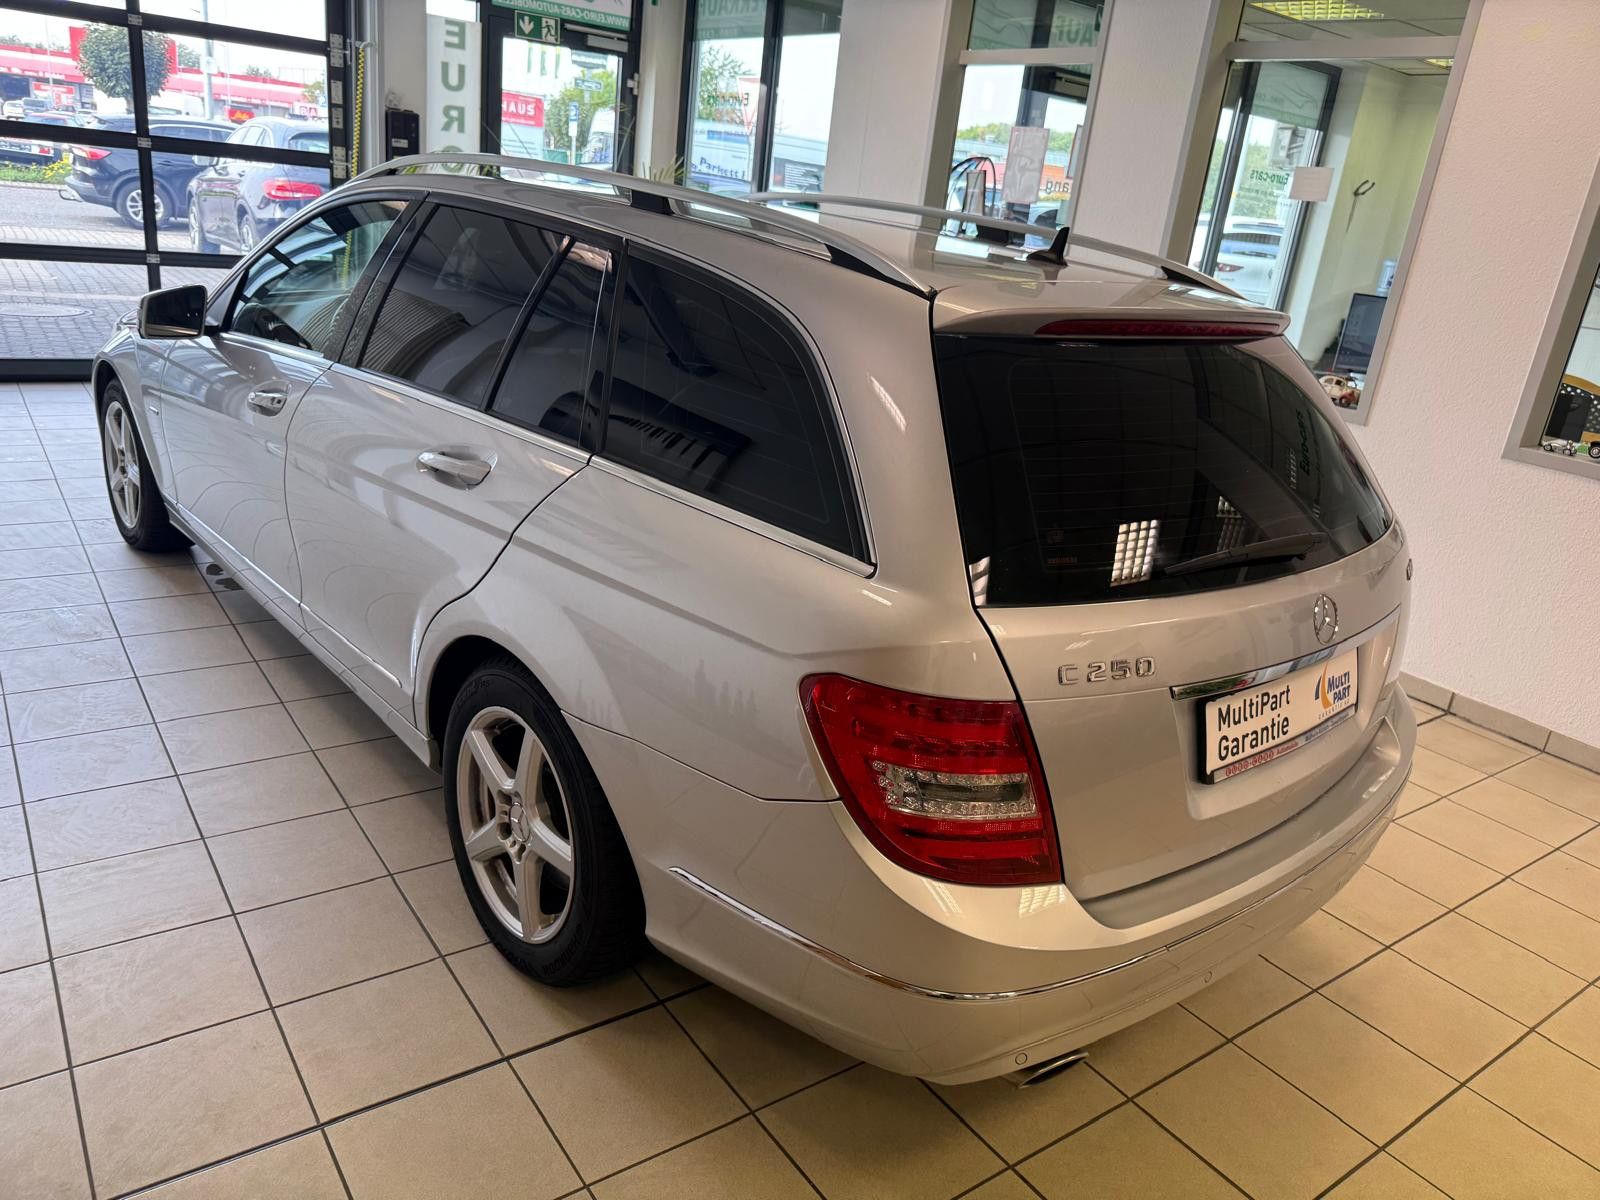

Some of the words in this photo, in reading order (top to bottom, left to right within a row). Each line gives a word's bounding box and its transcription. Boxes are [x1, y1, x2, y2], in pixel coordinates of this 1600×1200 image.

[1058, 664, 1079, 685] C
[1087, 656, 1155, 682] 250
[1327, 671, 1350, 694] MULTI
[1217, 685, 1290, 732] MultiPart
[1333, 685, 1351, 705] PART
[1218, 713, 1289, 761] Garantie
